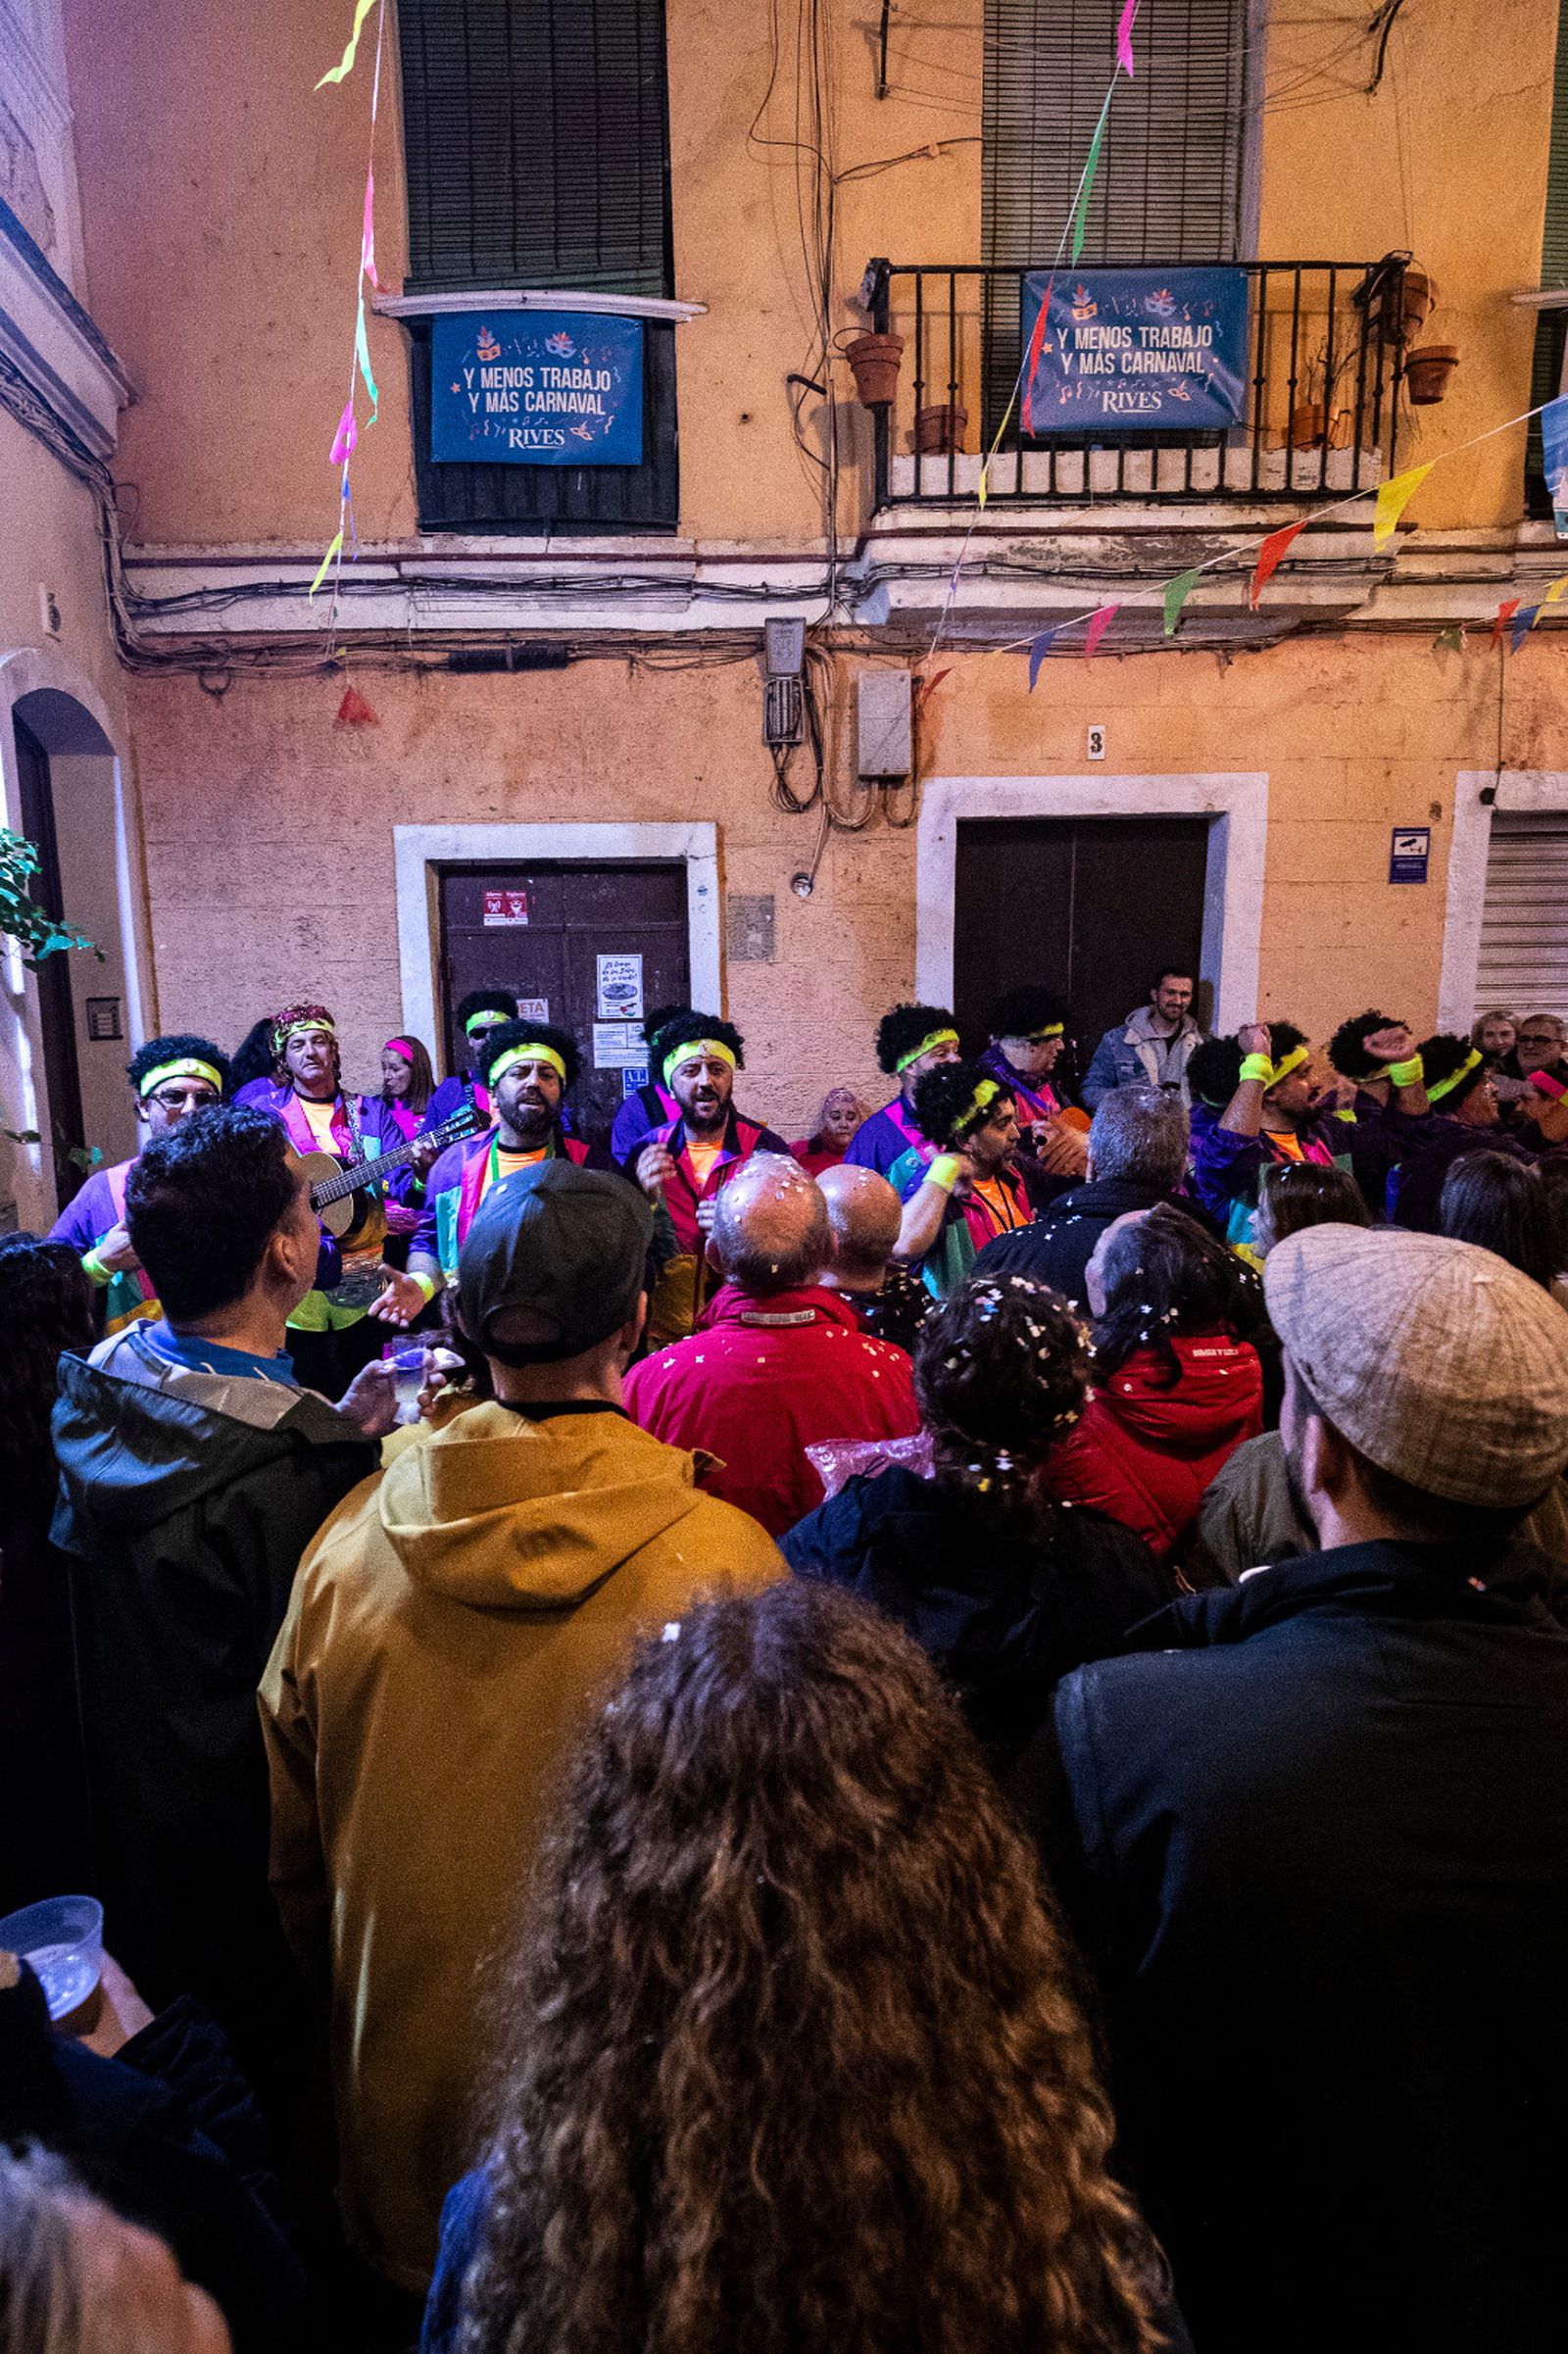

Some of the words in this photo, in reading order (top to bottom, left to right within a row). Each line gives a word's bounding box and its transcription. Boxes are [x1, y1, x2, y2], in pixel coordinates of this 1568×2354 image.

[1056, 327, 1069, 350] Y
[1074, 325, 1132, 350] MENOS
[1138, 324, 1213, 349] TRABAJO
[1060, 353, 1073, 375] Y
[1079, 349, 1116, 375] MÁS
[1121, 350, 1205, 375] CARNAVAL
[464, 368, 475, 389] Y
[480, 367, 534, 390] MENOS
[539, 367, 612, 392] TRABAJO
[467, 392, 480, 414] Y
[486, 387, 519, 414] MÁS
[524, 391, 606, 416] CARNAVAL
[1102, 390, 1162, 414] RIVES
[509, 427, 565, 450] RIVES
[1090, 731, 1103, 754] 3
